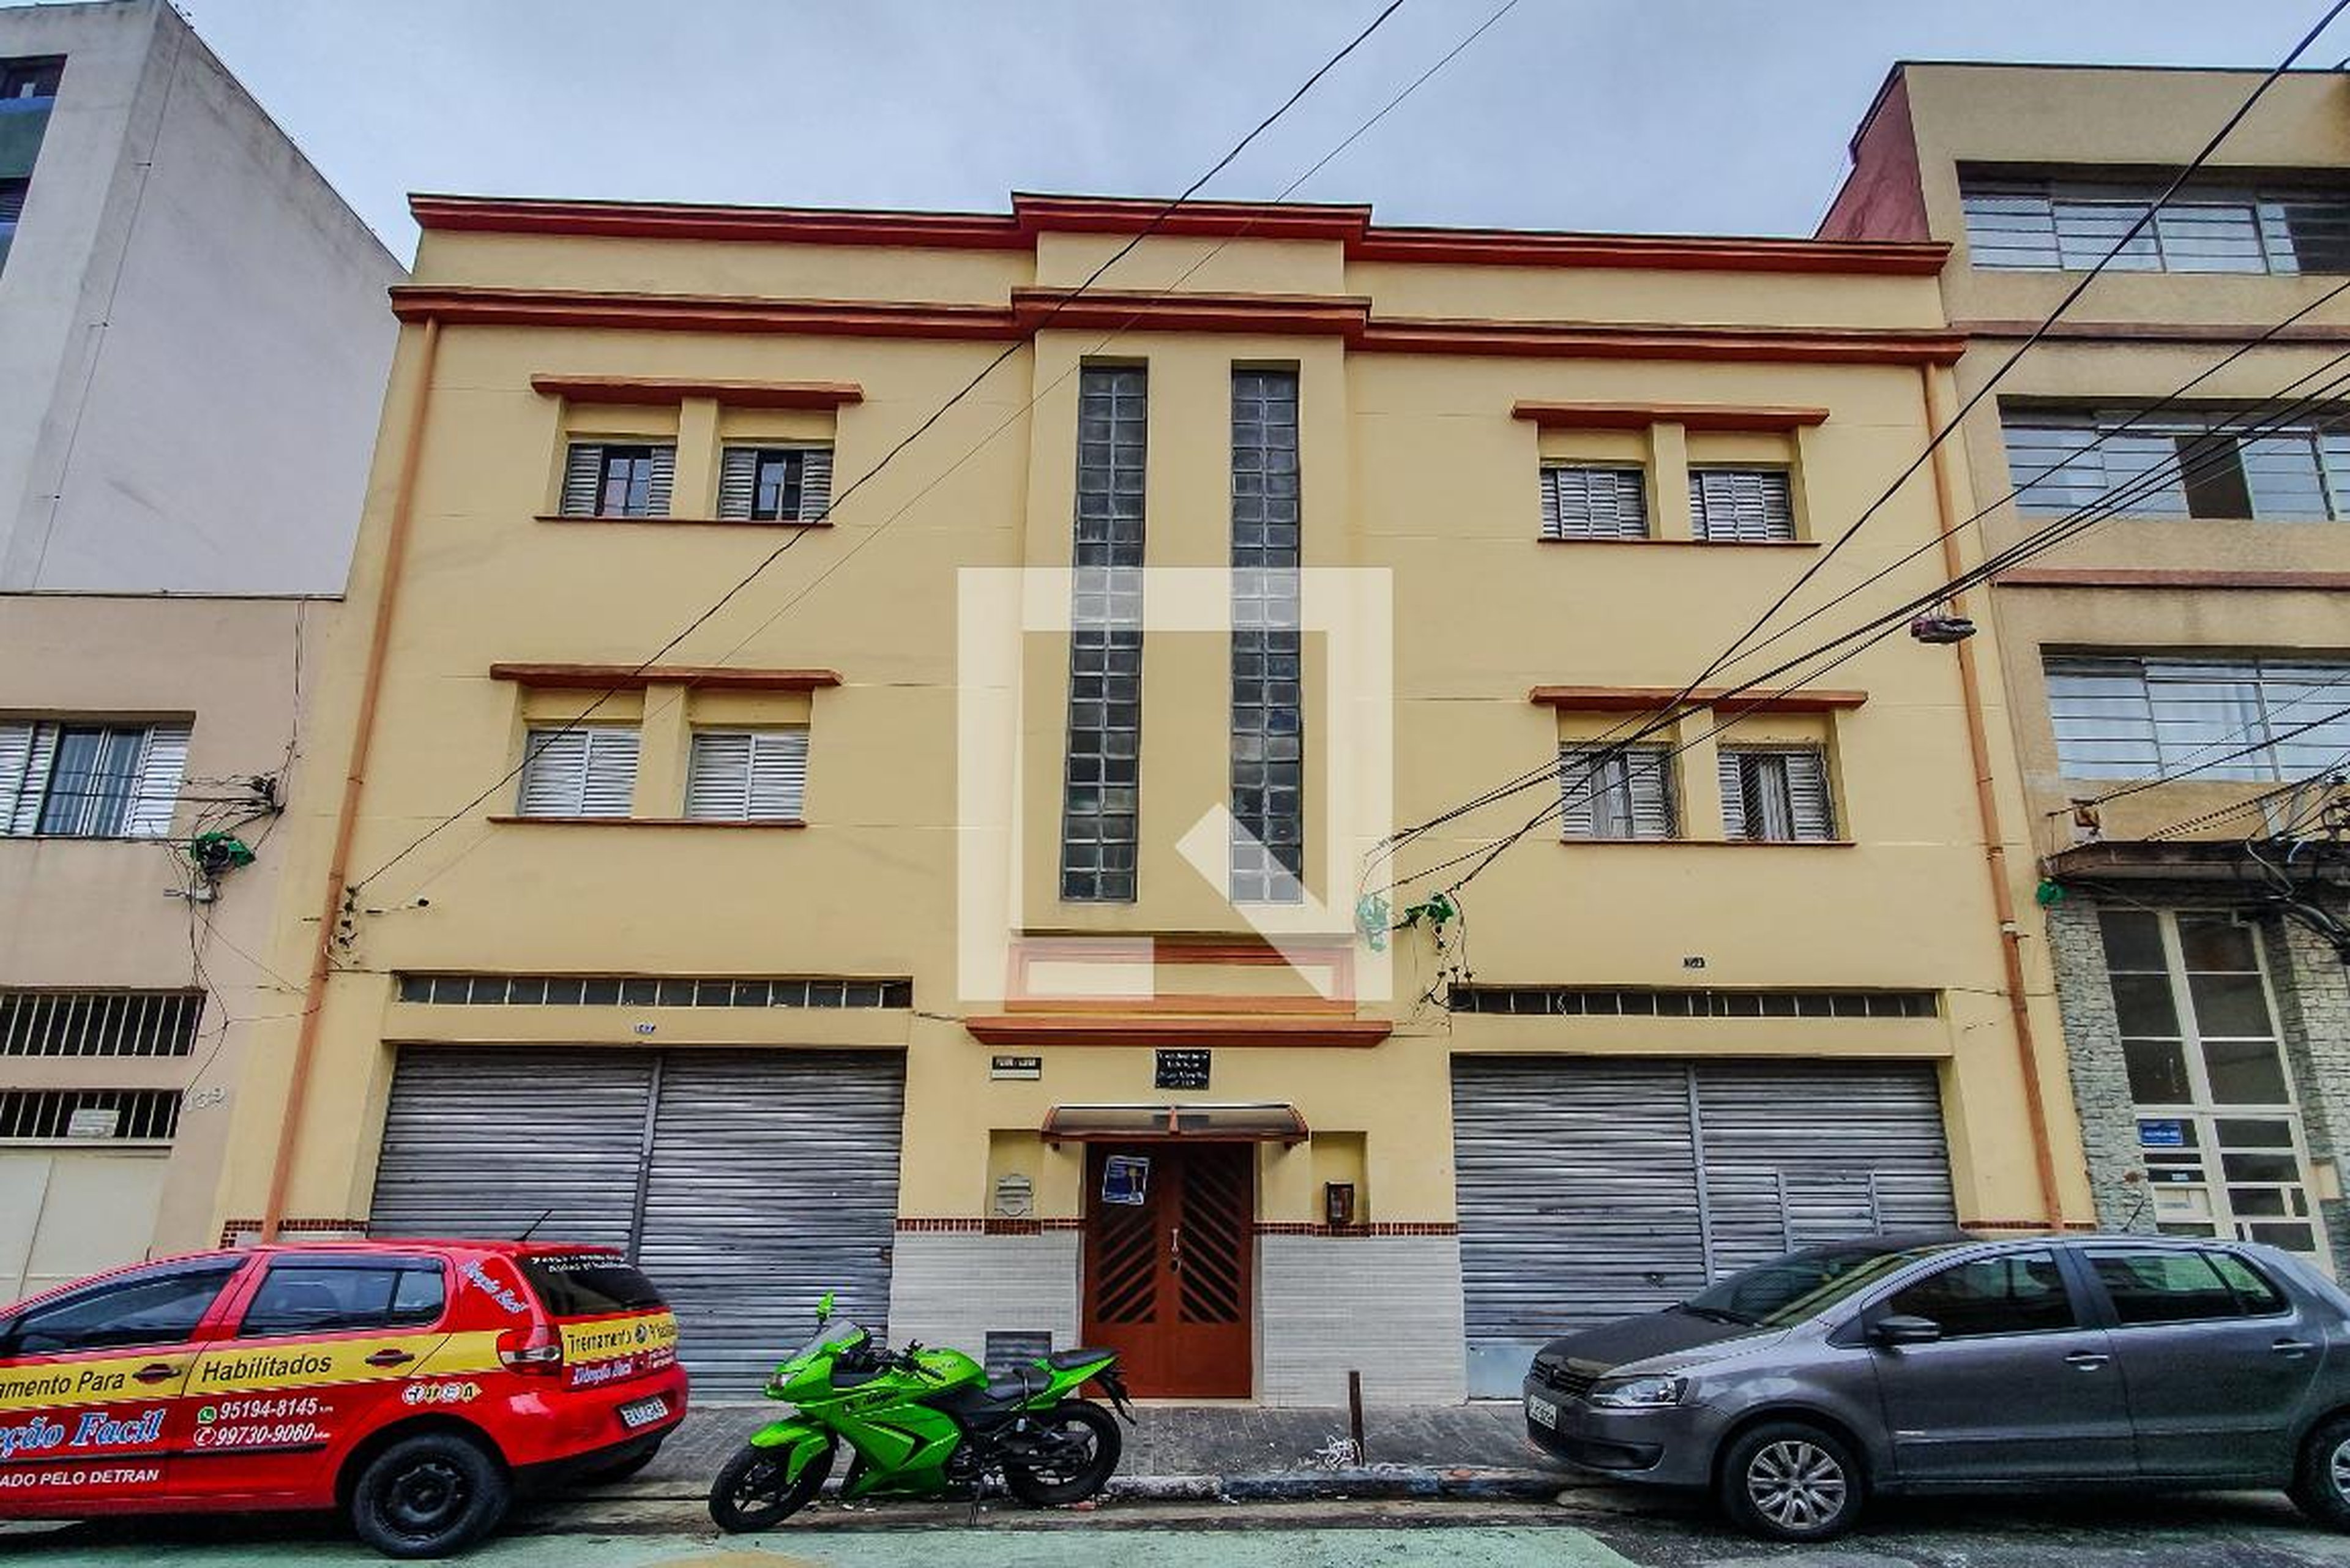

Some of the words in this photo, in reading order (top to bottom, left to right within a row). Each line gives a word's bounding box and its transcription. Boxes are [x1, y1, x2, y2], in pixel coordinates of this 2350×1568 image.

[77, 1371, 125, 1392] Para
[201, 1353, 332, 1383] Habilitados
[220, 1397, 319, 1420] 95194-8145
[215, 1422, 315, 1446] 99730-9060
[40, 1471, 86, 1485] PELO
[89, 1469, 159, 1484] DETRAN
